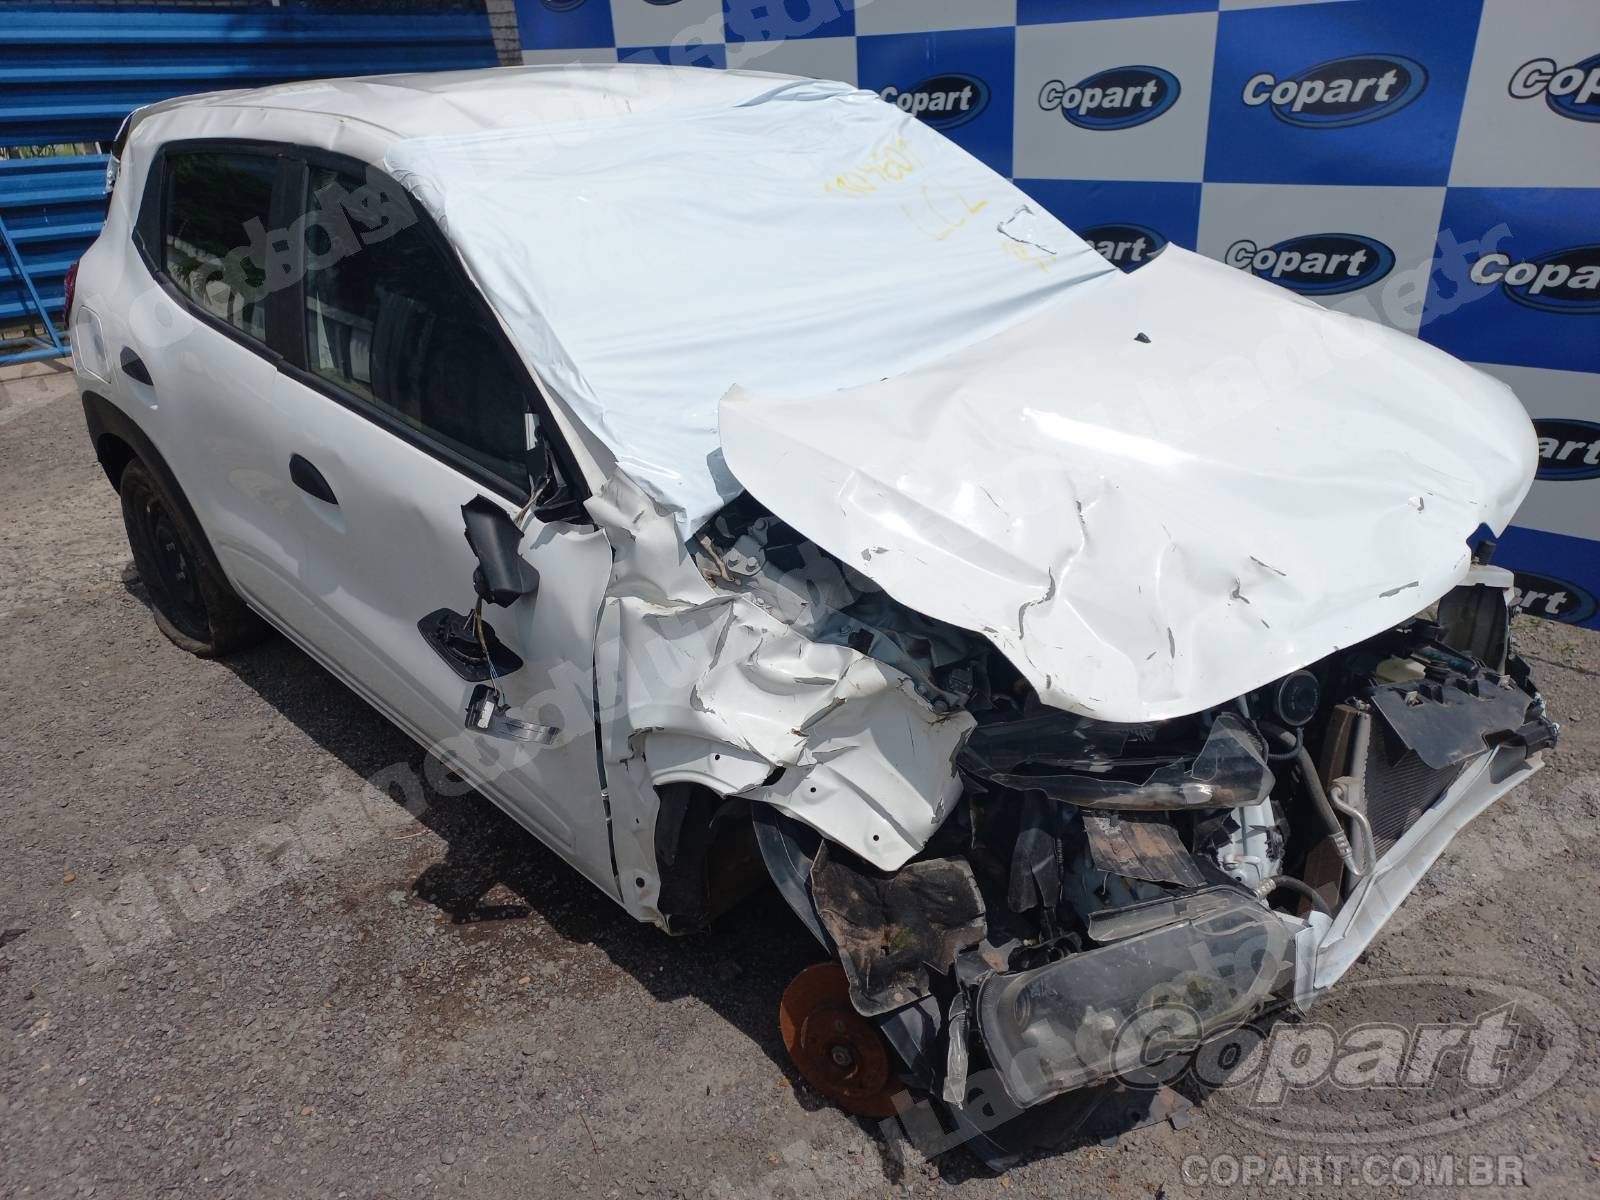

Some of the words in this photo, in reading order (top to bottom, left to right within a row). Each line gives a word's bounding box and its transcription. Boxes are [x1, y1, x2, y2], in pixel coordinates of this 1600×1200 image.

[1038, 79, 1158, 115] Copart
[1242, 68, 1399, 112] Copart
[1508, 57, 1600, 104] Cop
[1086, 235, 1148, 262] art
[1224, 239, 1369, 278] Copart
[1470, 253, 1600, 295] Copa
